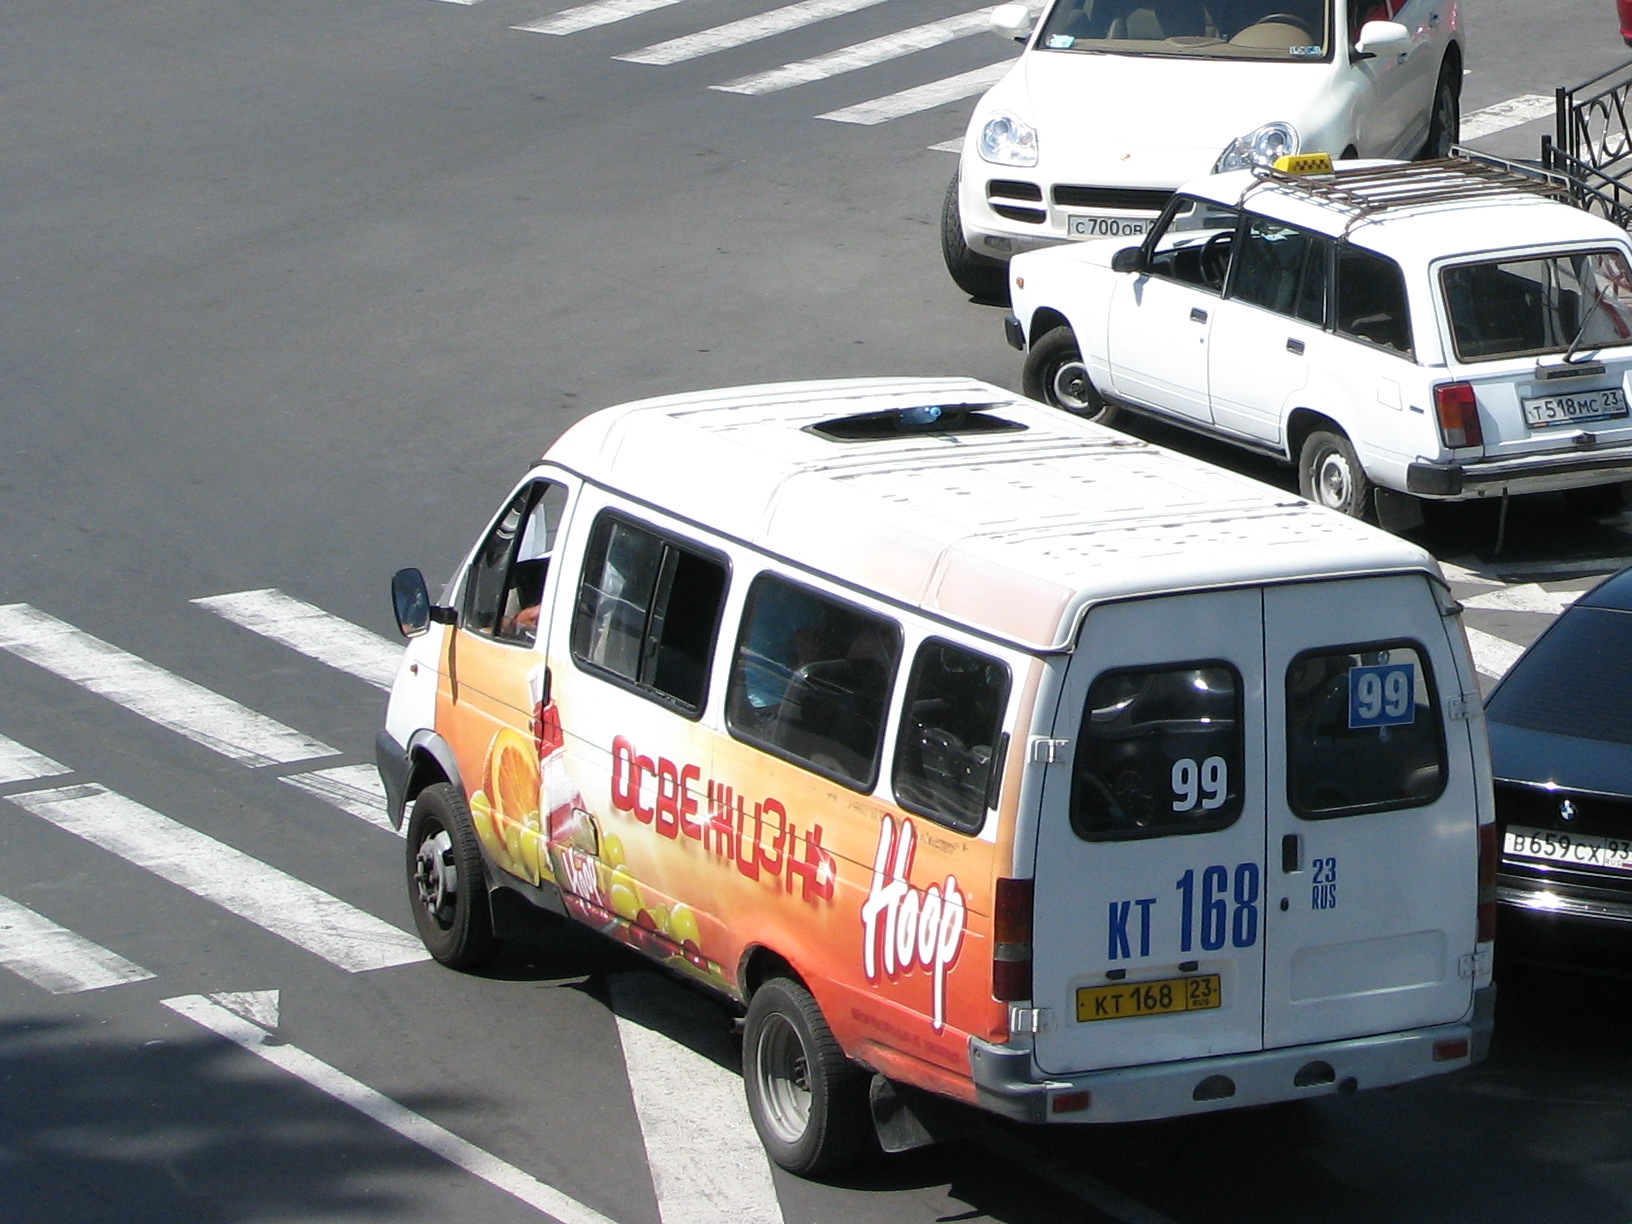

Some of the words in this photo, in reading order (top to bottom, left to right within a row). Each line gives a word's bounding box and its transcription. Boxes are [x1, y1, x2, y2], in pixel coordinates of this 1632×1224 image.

[1602, 392, 1618, 407] 23
[1358, 670, 1409, 720] 99
[1171, 755, 1228, 812] 99
[1513, 832, 1600, 864] В659СХ
[1608, 841, 1630, 860] 93
[1176, 862, 1259, 953] 168
[1312, 857, 1337, 884] 23
[1312, 883, 1337, 910] RUS
[861, 813, 968, 1035] Hoop
[1190, 979, 1213, 1000] 23
